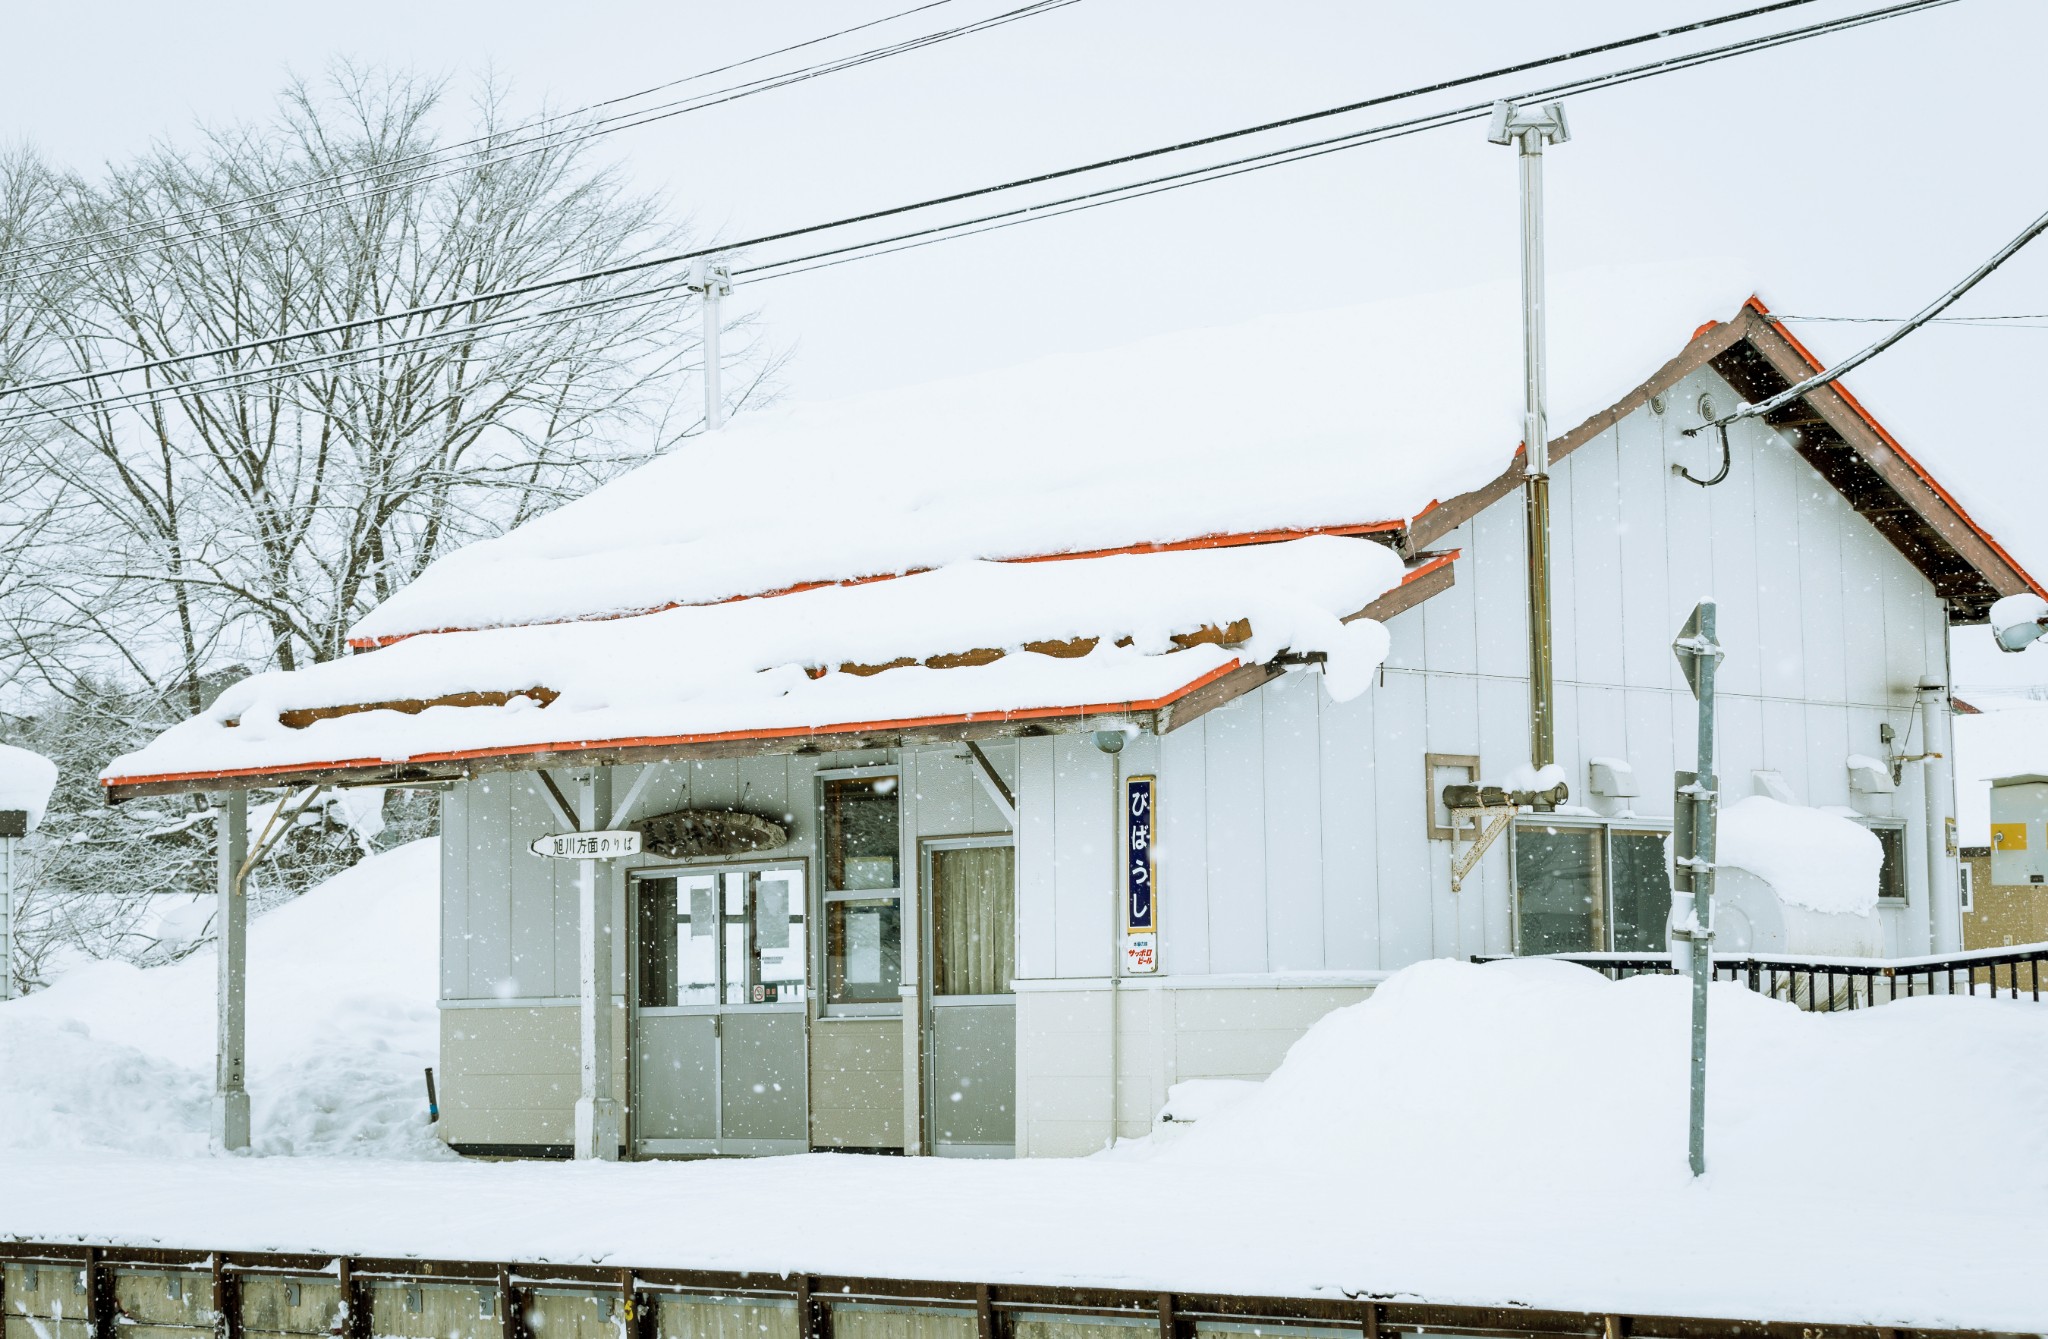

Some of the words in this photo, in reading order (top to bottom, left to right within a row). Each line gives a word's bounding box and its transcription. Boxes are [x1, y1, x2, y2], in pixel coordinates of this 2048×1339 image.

[552, 837, 634, 855] 旭川方面のりば
[1131, 791, 1151, 919] びばうし
[1128, 949, 1153, 957] サッポロ
[1137, 957, 1153, 965] ビール
